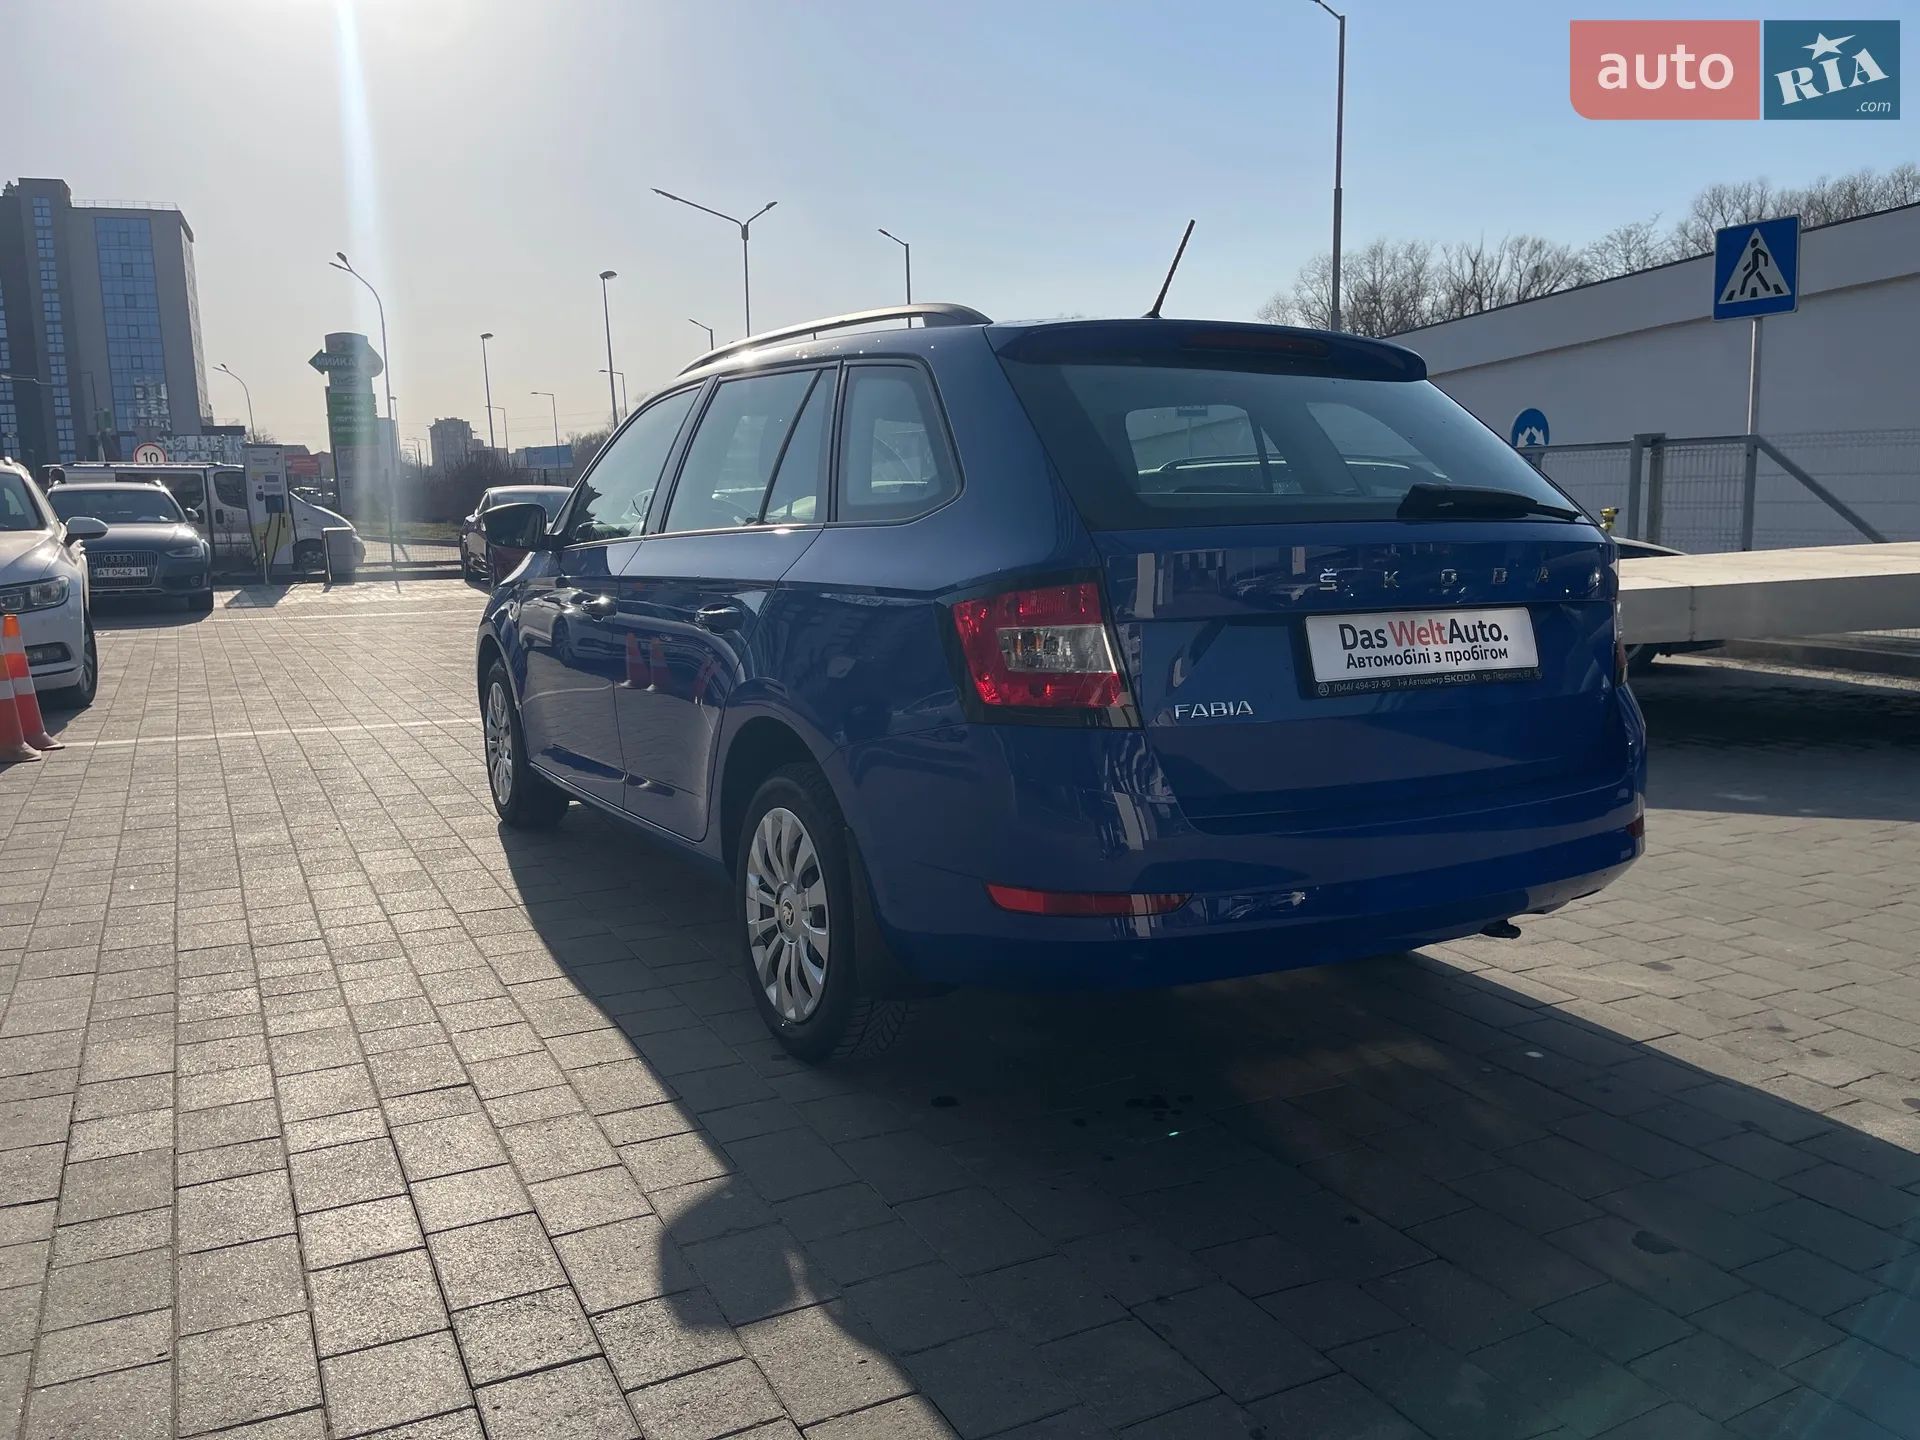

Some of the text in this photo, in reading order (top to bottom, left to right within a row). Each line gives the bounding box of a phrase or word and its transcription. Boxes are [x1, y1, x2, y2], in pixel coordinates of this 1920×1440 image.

[316, 357, 356, 367] МИЙКА
[143, 452, 158, 463] 10
[112, 568, 132, 576] 0462
[136, 568, 147, 576] IM
[1319, 567, 1550, 592] ŠKODA
[1339, 624, 1388, 650] Das
[1346, 644, 1509, 670] Автомобілі з пробігом
[1355, 679, 1391, 691] 494-37-90
[1397, 677, 1408, 688] 1-й
[1408, 676, 1444, 687] Автоцентр
[1174, 700, 1254, 720] FABIA
